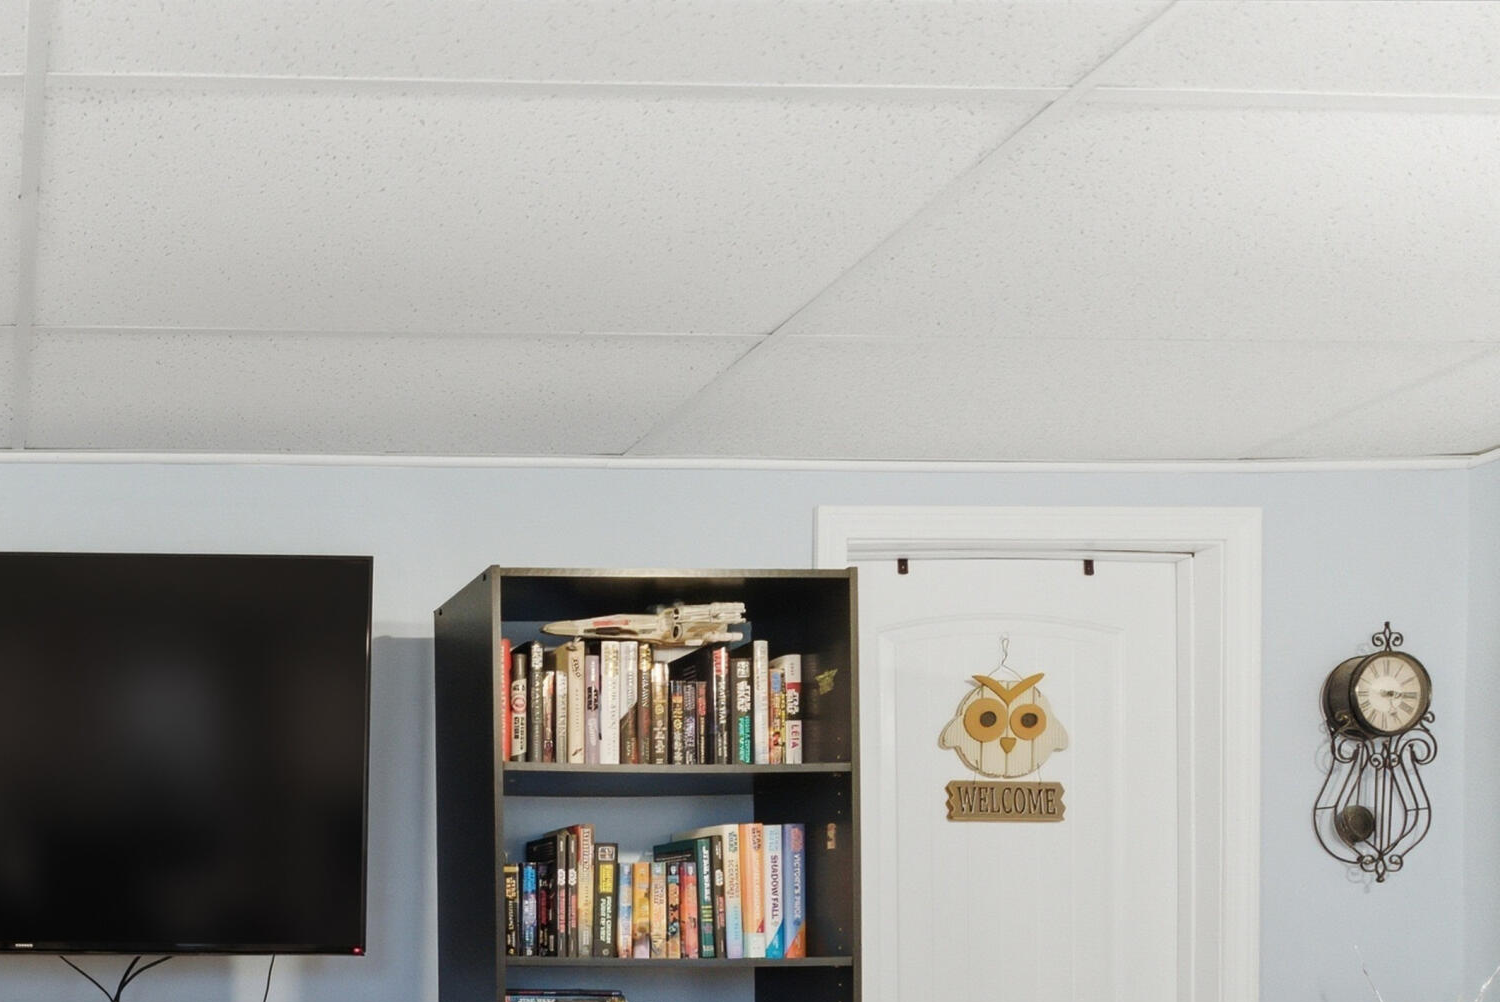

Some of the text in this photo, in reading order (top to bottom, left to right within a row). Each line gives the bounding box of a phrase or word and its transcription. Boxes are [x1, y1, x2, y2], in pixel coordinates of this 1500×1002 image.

[791, 724, 800, 749] LEIA
[956, 786, 1057, 815] WELCOME
[770, 854, 779, 919] SHADOW FALL
